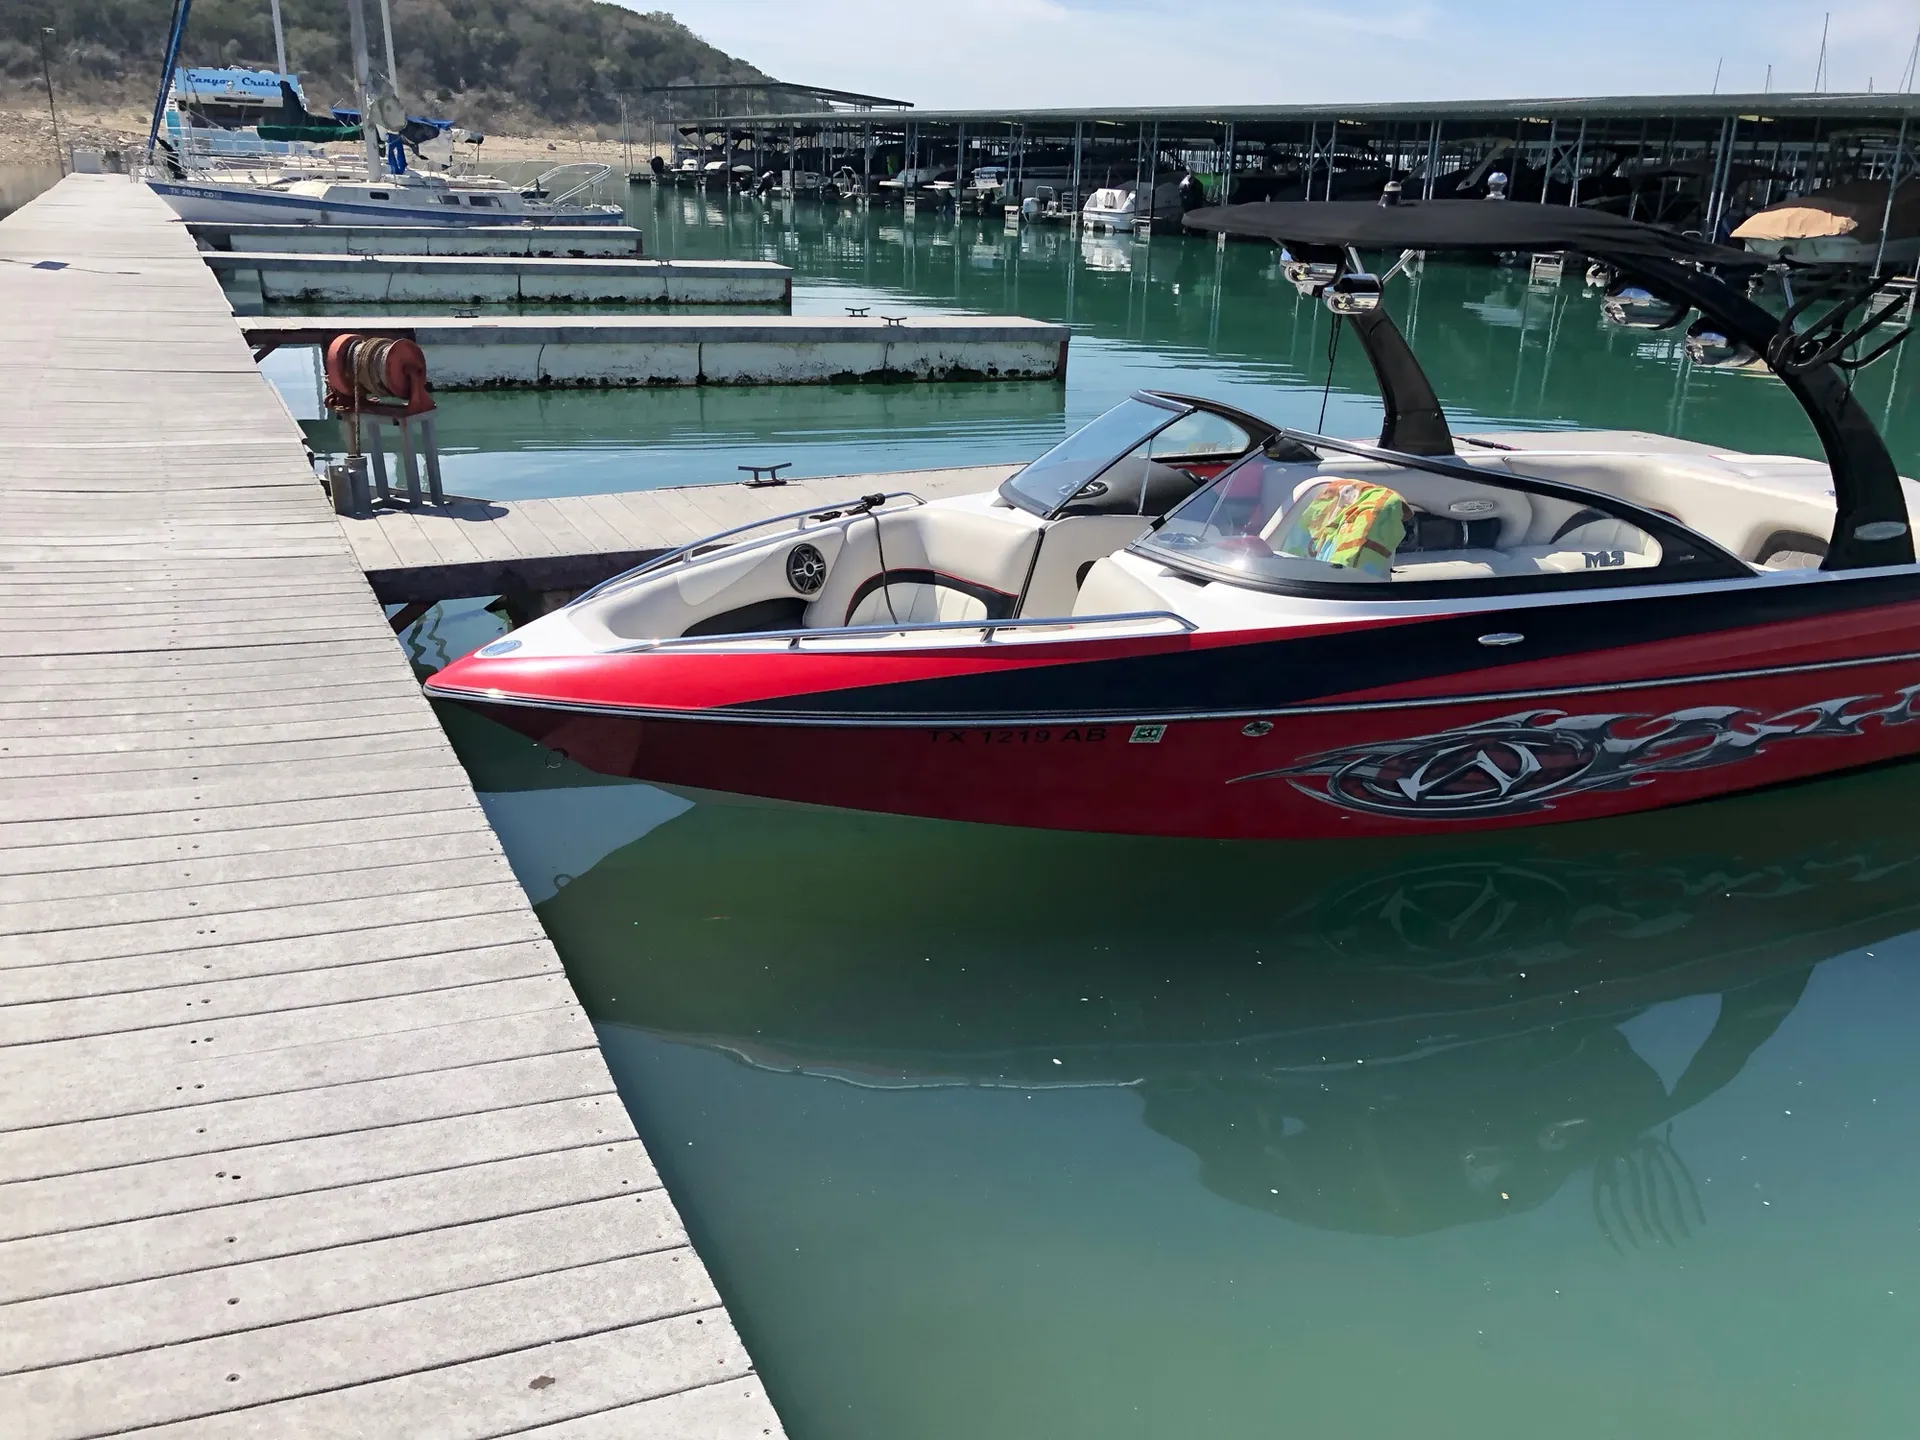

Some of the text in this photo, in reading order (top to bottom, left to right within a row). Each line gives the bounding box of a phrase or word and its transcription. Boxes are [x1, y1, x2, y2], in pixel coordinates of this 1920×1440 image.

[186, 74, 234, 86] Canyo
[929, 728, 1106, 744] TX 1219 AB
